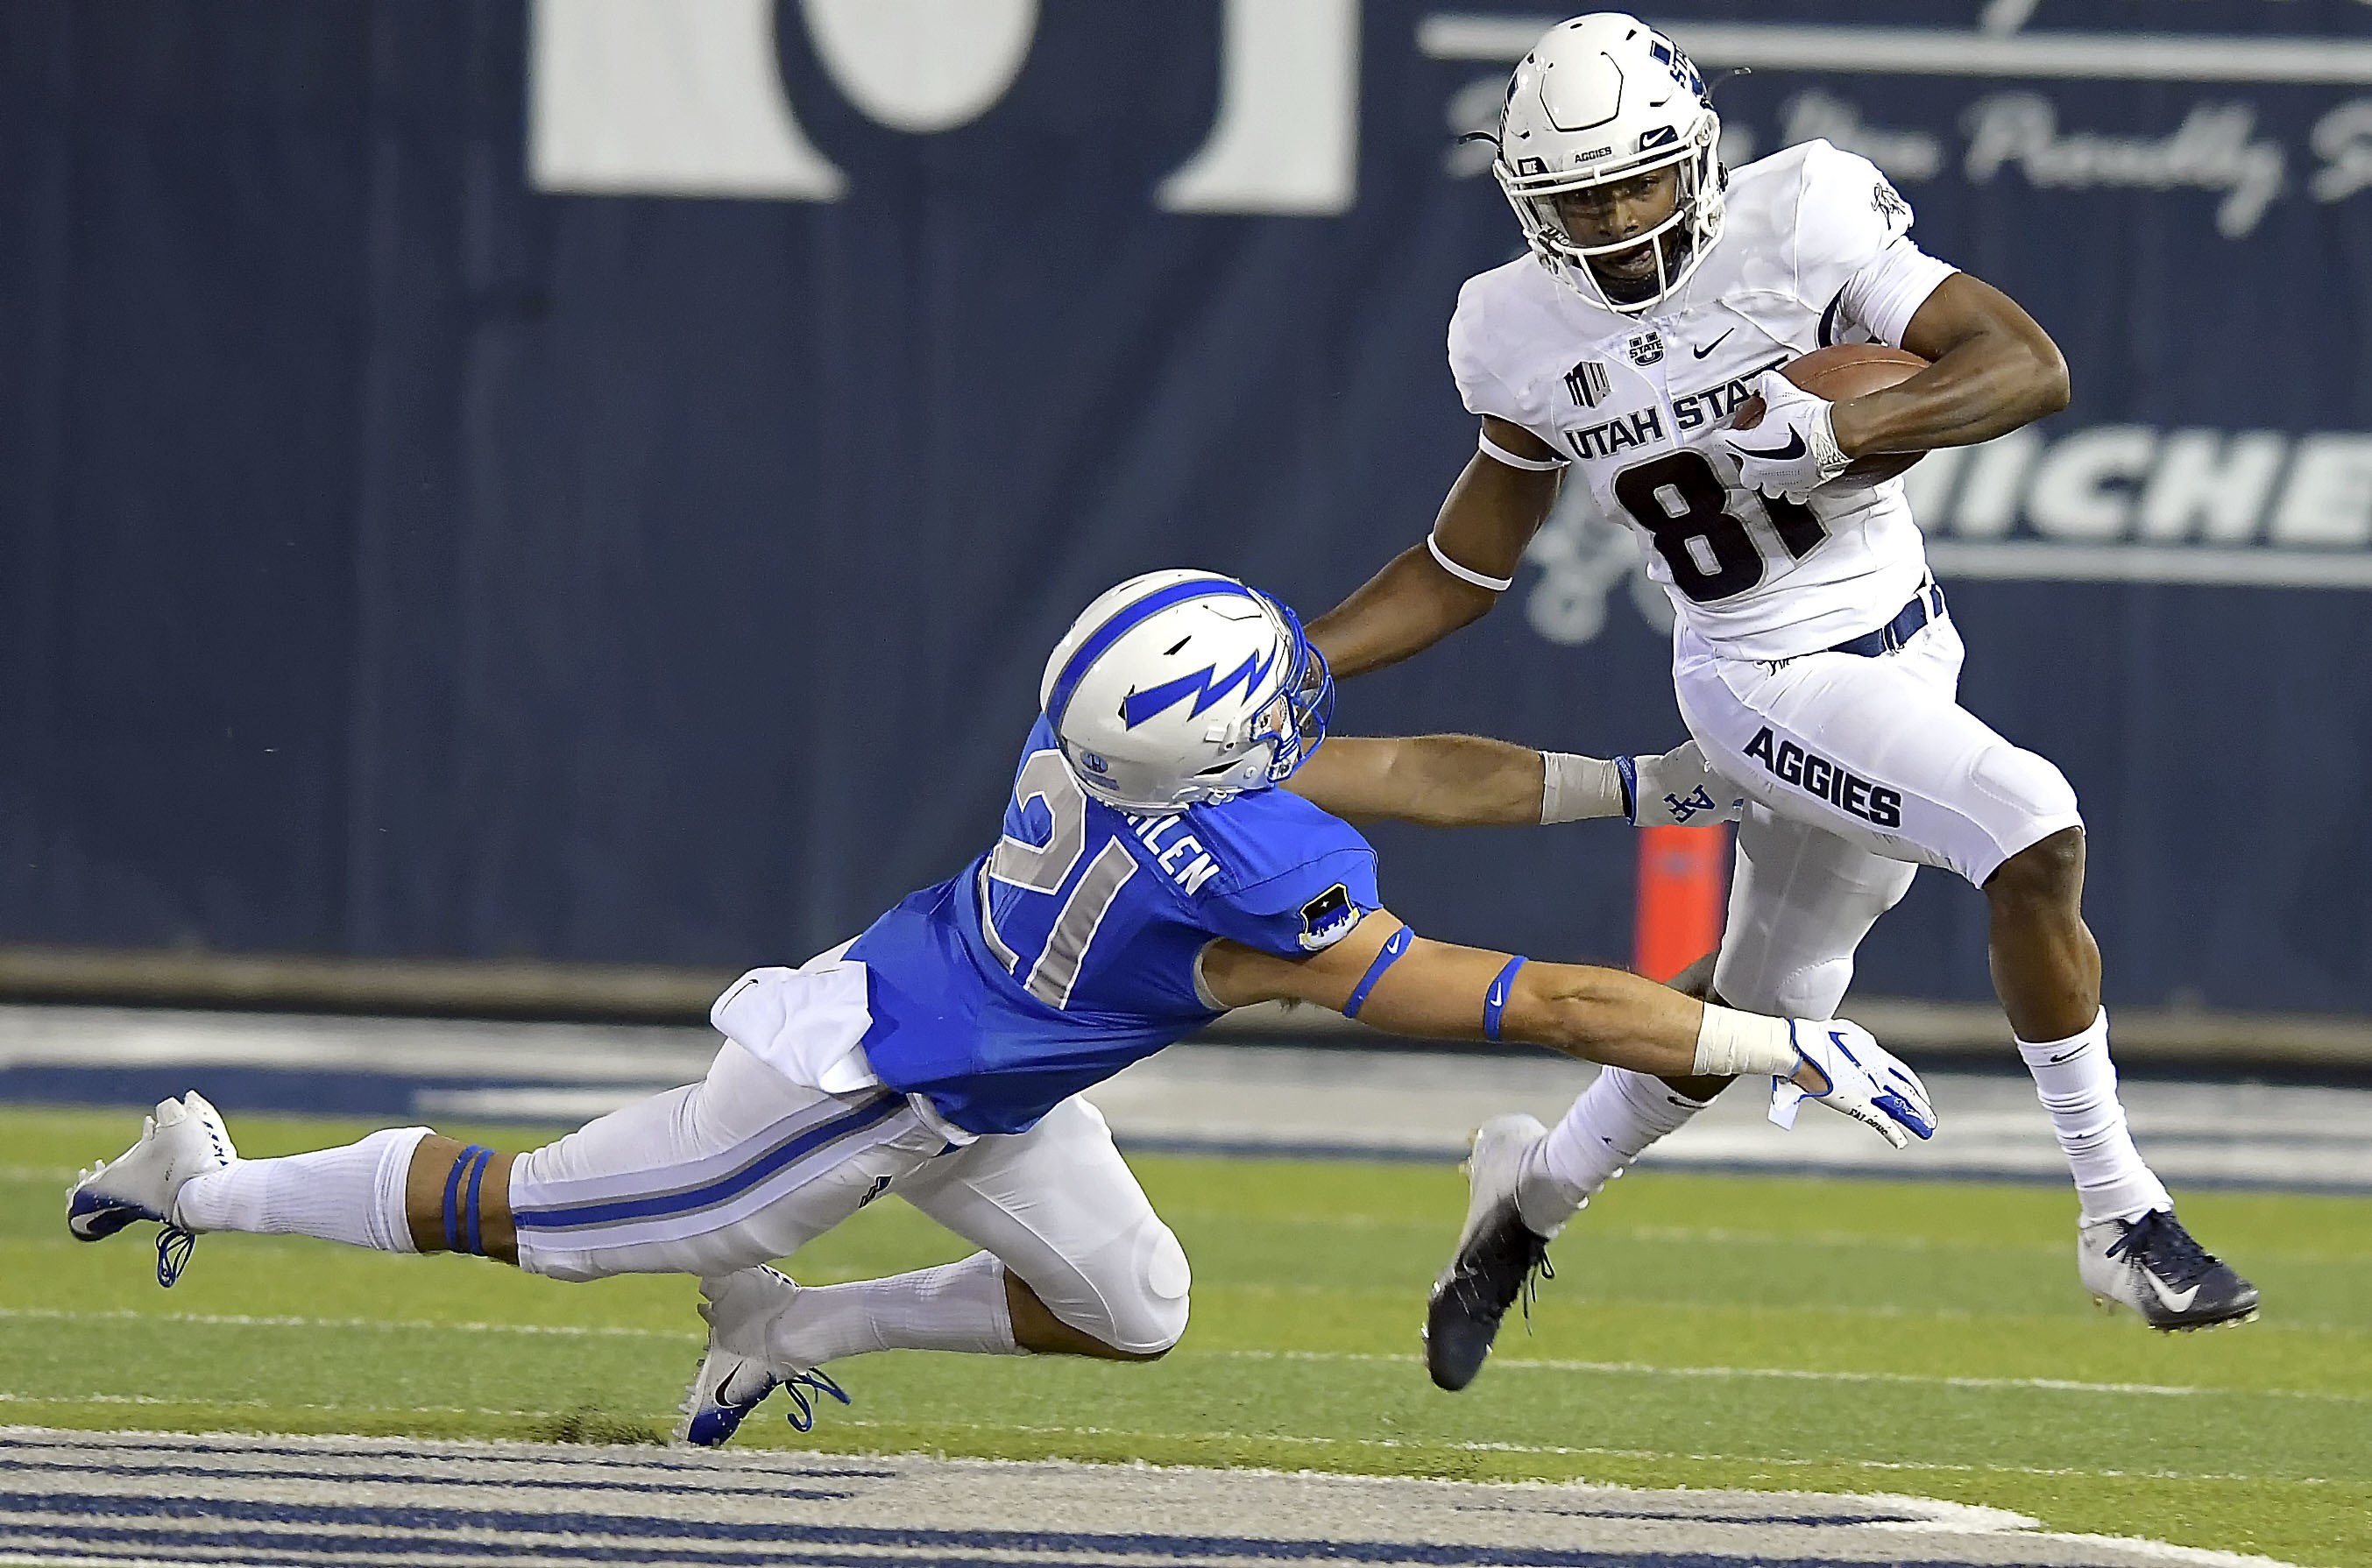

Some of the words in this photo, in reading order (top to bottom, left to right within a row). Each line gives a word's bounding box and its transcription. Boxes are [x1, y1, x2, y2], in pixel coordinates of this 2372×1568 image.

[1575, 146, 1612, 164] AGGIES
[1564, 406, 1664, 460] UTAH
[1672, 354, 1790, 430] STA
[1742, 725, 1901, 828] AGGIES
[980, 748, 1139, 1009] 21
